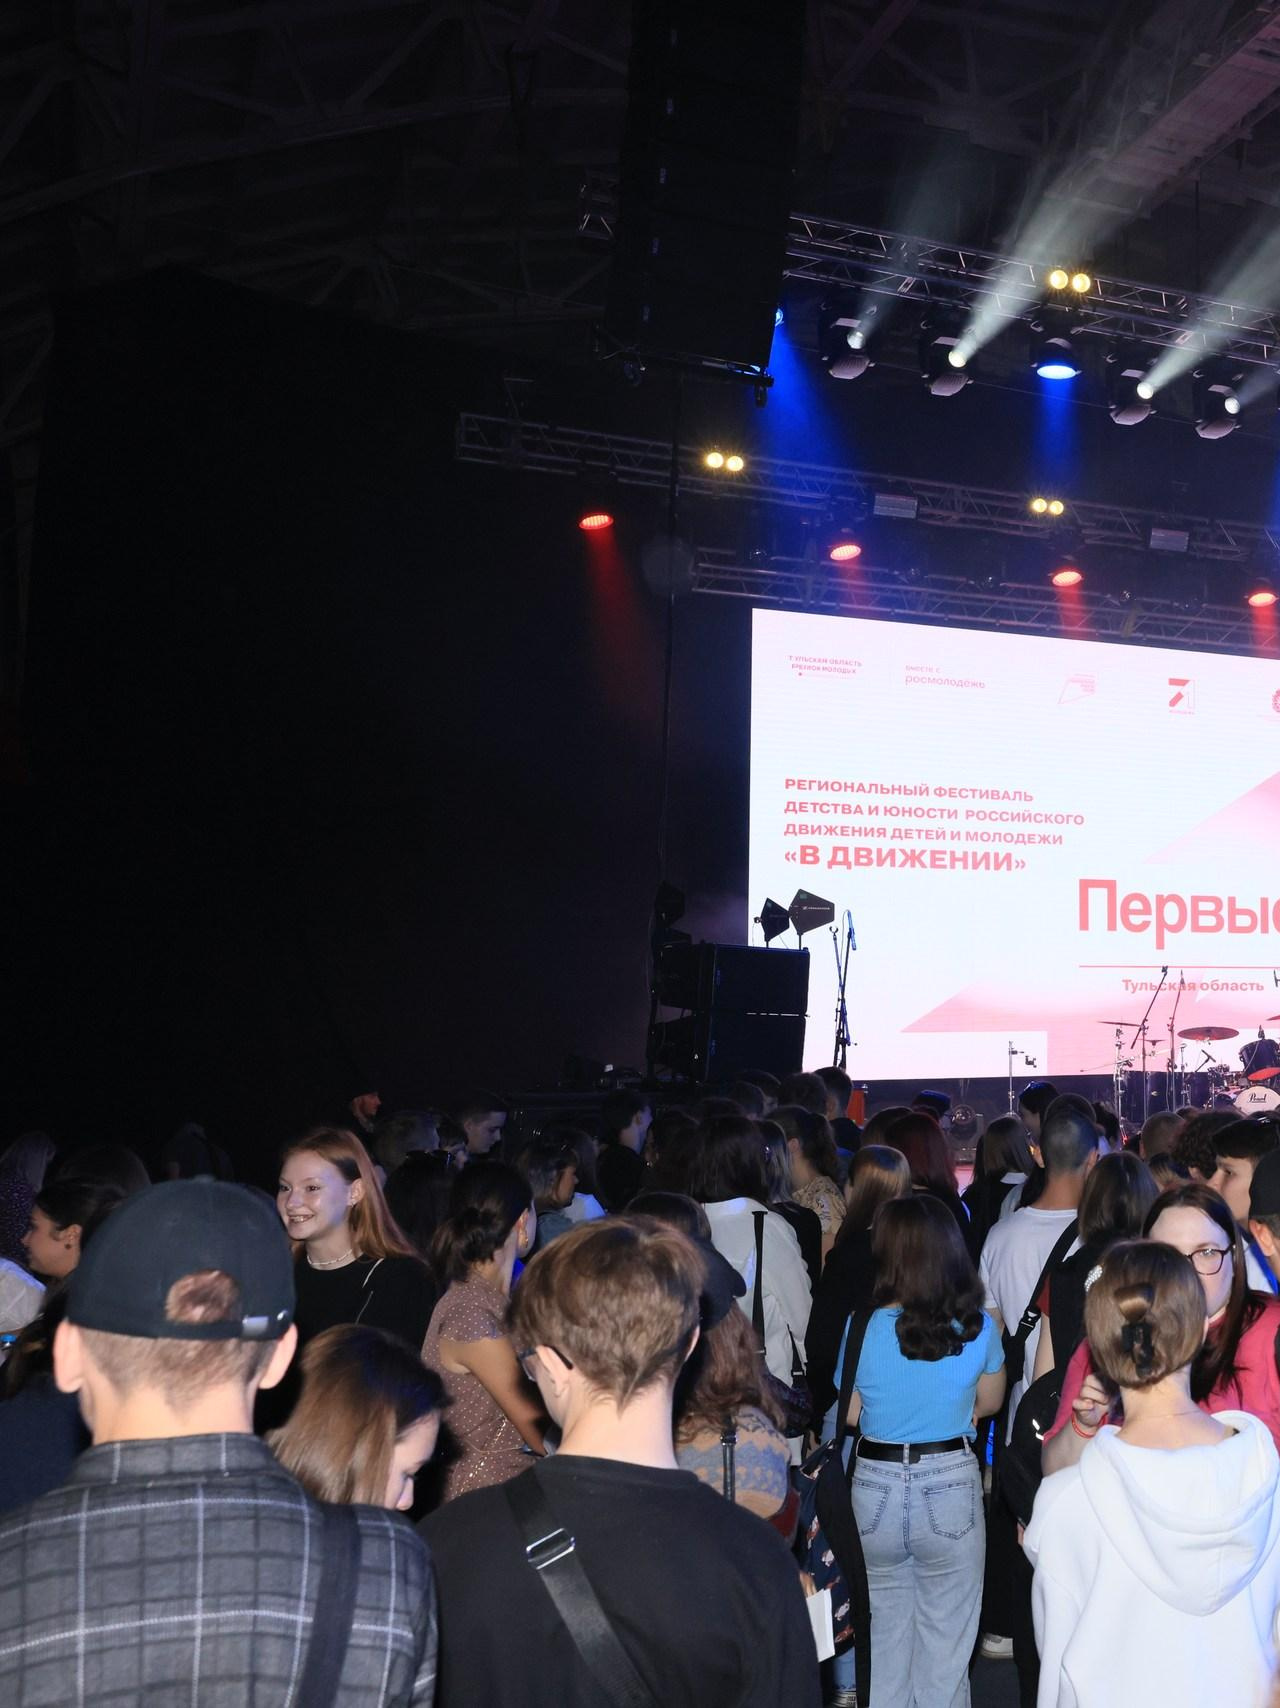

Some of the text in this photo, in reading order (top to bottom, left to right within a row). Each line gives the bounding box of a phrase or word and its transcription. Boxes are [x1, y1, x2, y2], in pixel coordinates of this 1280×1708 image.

[784, 778, 1034, 802] РЕГИОНАЛЬНЫЙ ФЕСТИВАЛЬ
[784, 801, 1085, 826] ДЕТСТВА И ЮНОСТИ РОССИЙСКОГО
[783, 823, 1063, 846] ДВИЖЕНИЯ ДЕТЕЙ И МОЛОДЕЖИ
[784, 844, 1027, 872] «В ДВИЖЕНИИ»
[1200, 979, 1265, 992] область
